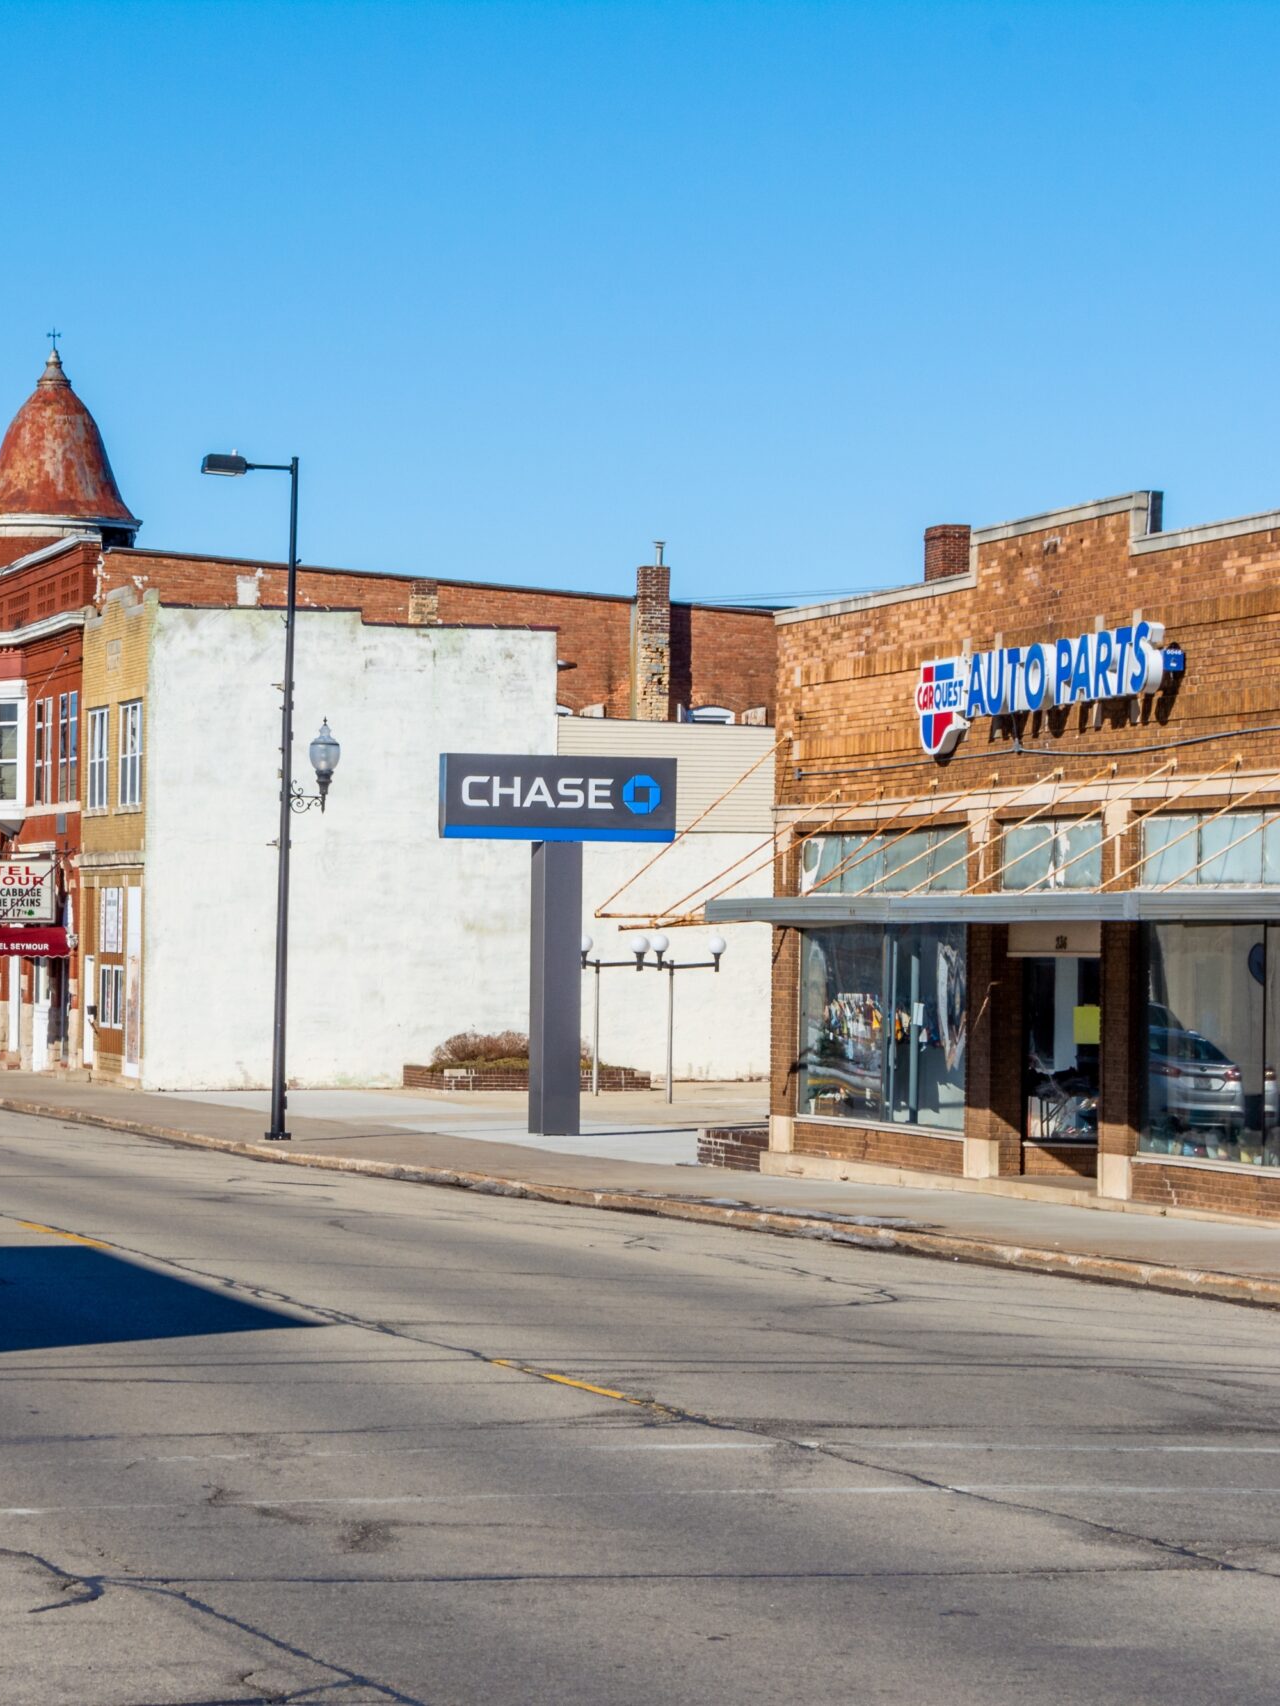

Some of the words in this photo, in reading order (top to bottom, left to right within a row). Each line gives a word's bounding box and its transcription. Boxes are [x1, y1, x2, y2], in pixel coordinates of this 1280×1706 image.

[966, 643, 1045, 718] AUTO
[1054, 620, 1151, 706] PARTS
[917, 680, 964, 711] CARQUEST
[461, 775, 615, 810] CHASE
[0, 888, 41, 897] CABBAGE
[10, 898, 41, 907] FIXINS
[10, 942, 49, 951] SEYMOUR
